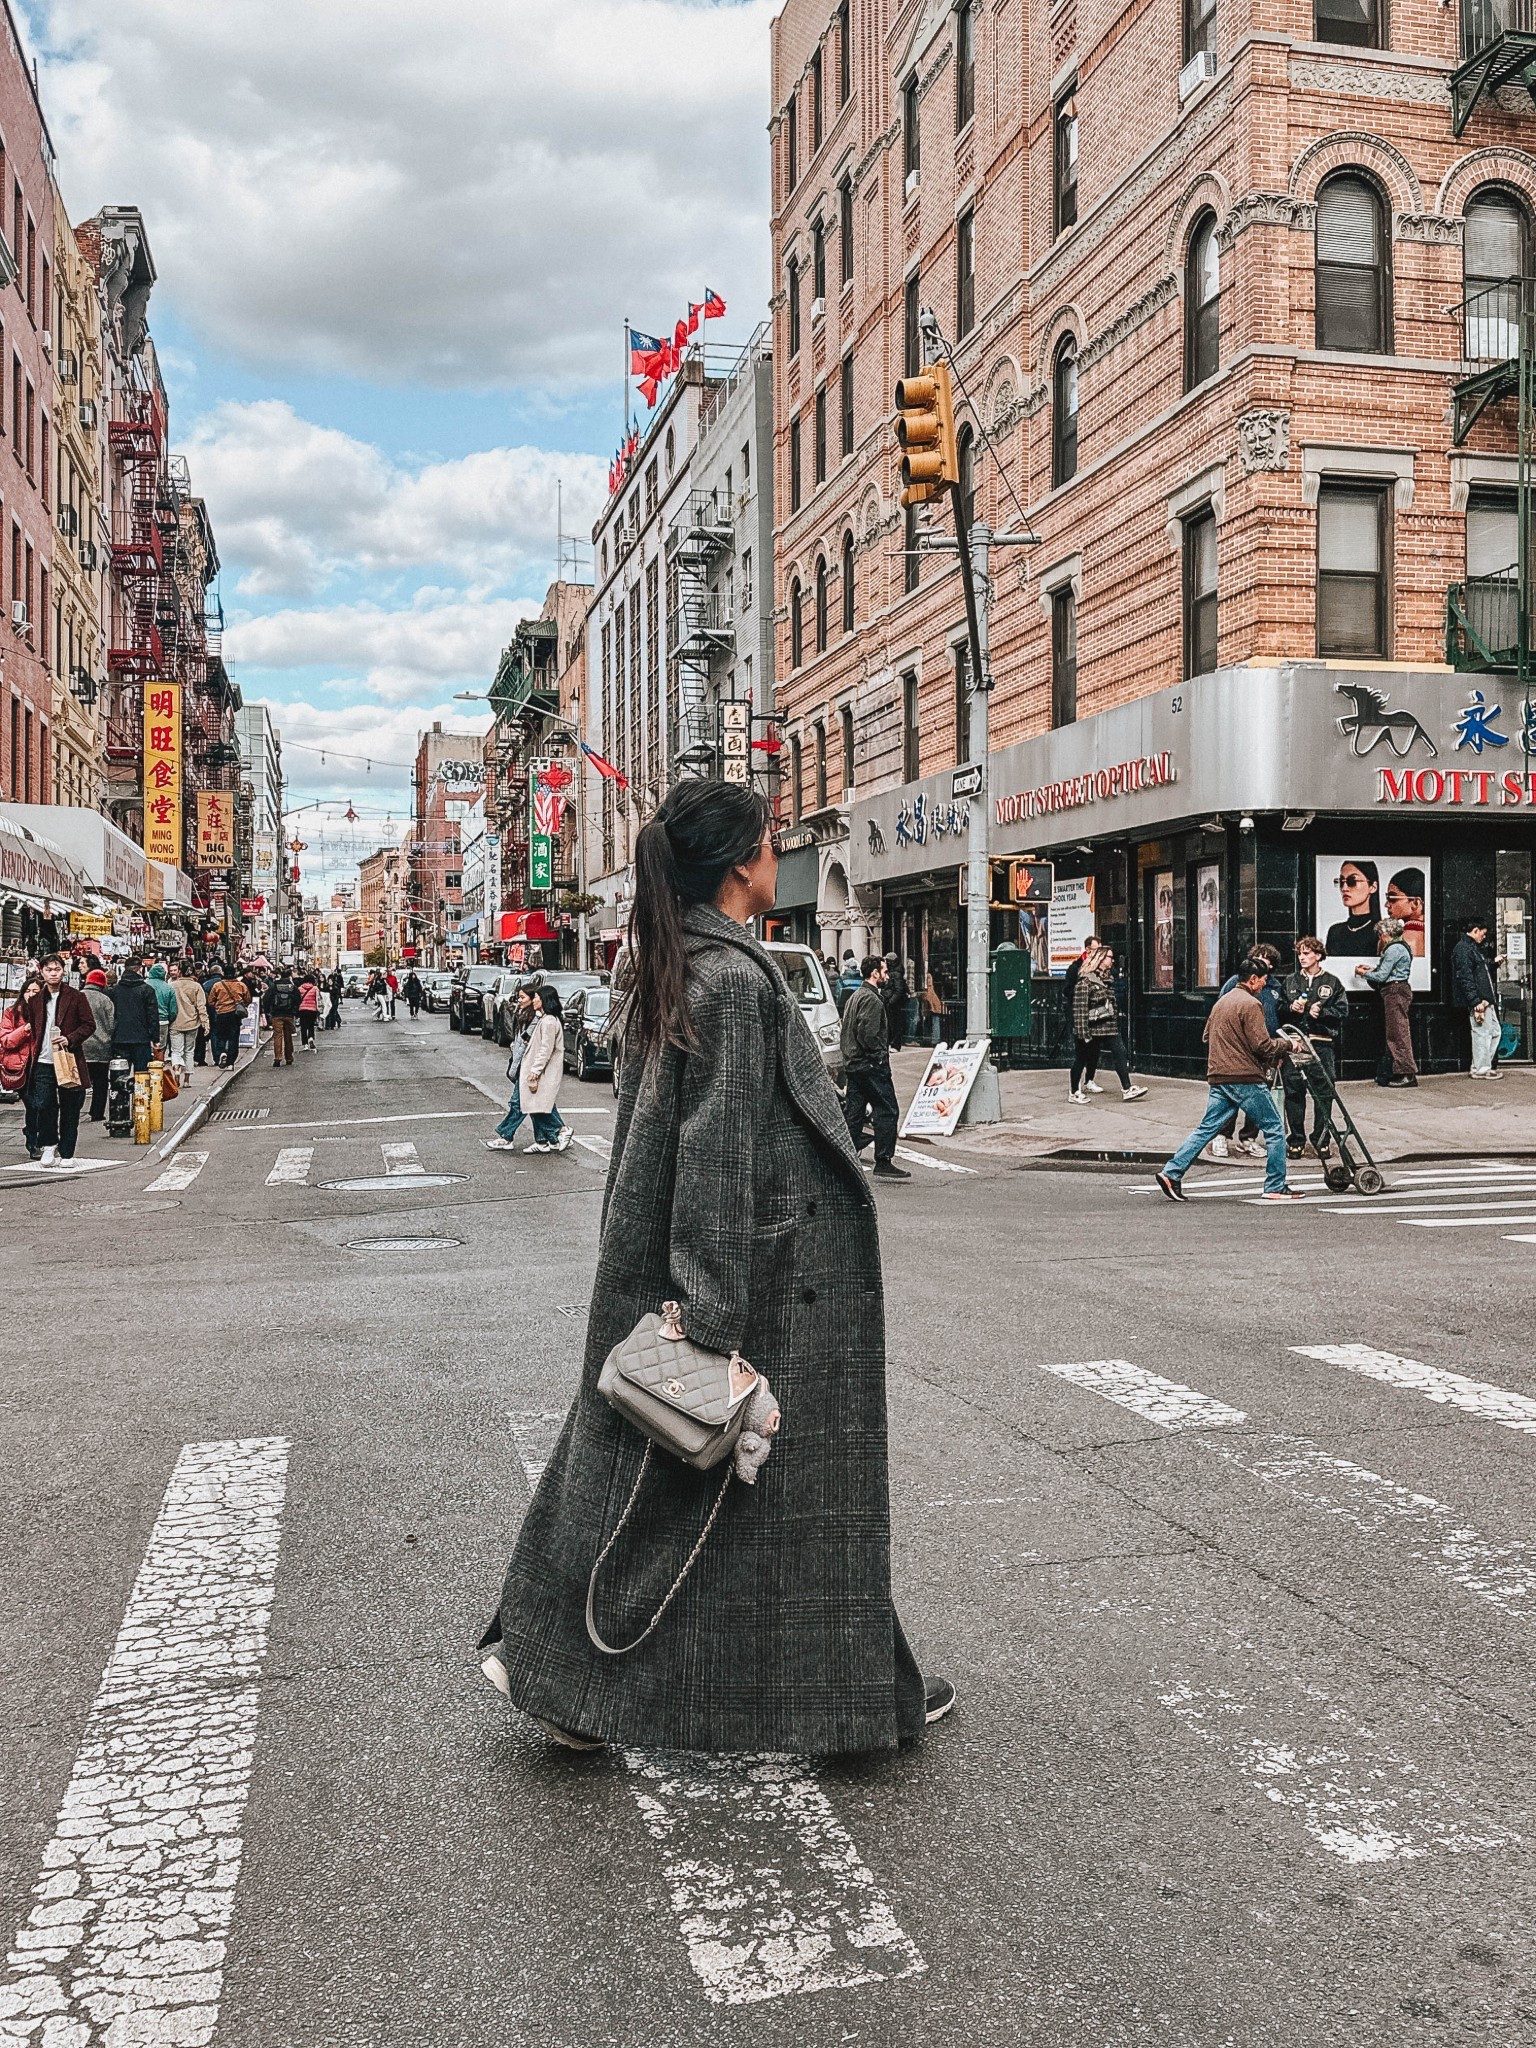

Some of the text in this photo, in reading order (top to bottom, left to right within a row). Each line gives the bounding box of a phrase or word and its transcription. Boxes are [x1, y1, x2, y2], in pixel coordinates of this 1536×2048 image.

[1171, 696, 1182, 714] 52
[148, 690, 176, 824] 明旺食堂
[956, 773, 979, 791] ONE WAY
[996, 750, 1178, 825] MOTT STREET OPTICAL
[1375, 767, 1496, 805] MOTT
[207, 794, 223, 828] 大旺
[152, 830, 172, 840] MING
[202, 830, 229, 841] 飯店
[149, 843, 174, 854] WONG
[206, 843, 225, 853] BIG
[200, 854, 232, 865] WONG
[533, 842, 549, 879] 酒家
[28, 859, 37, 886] OF
[1057, 884, 1075, 893] SMARTER
[1076, 882, 1084, 891] THIS
[1066, 893, 1076, 901] YEAR
